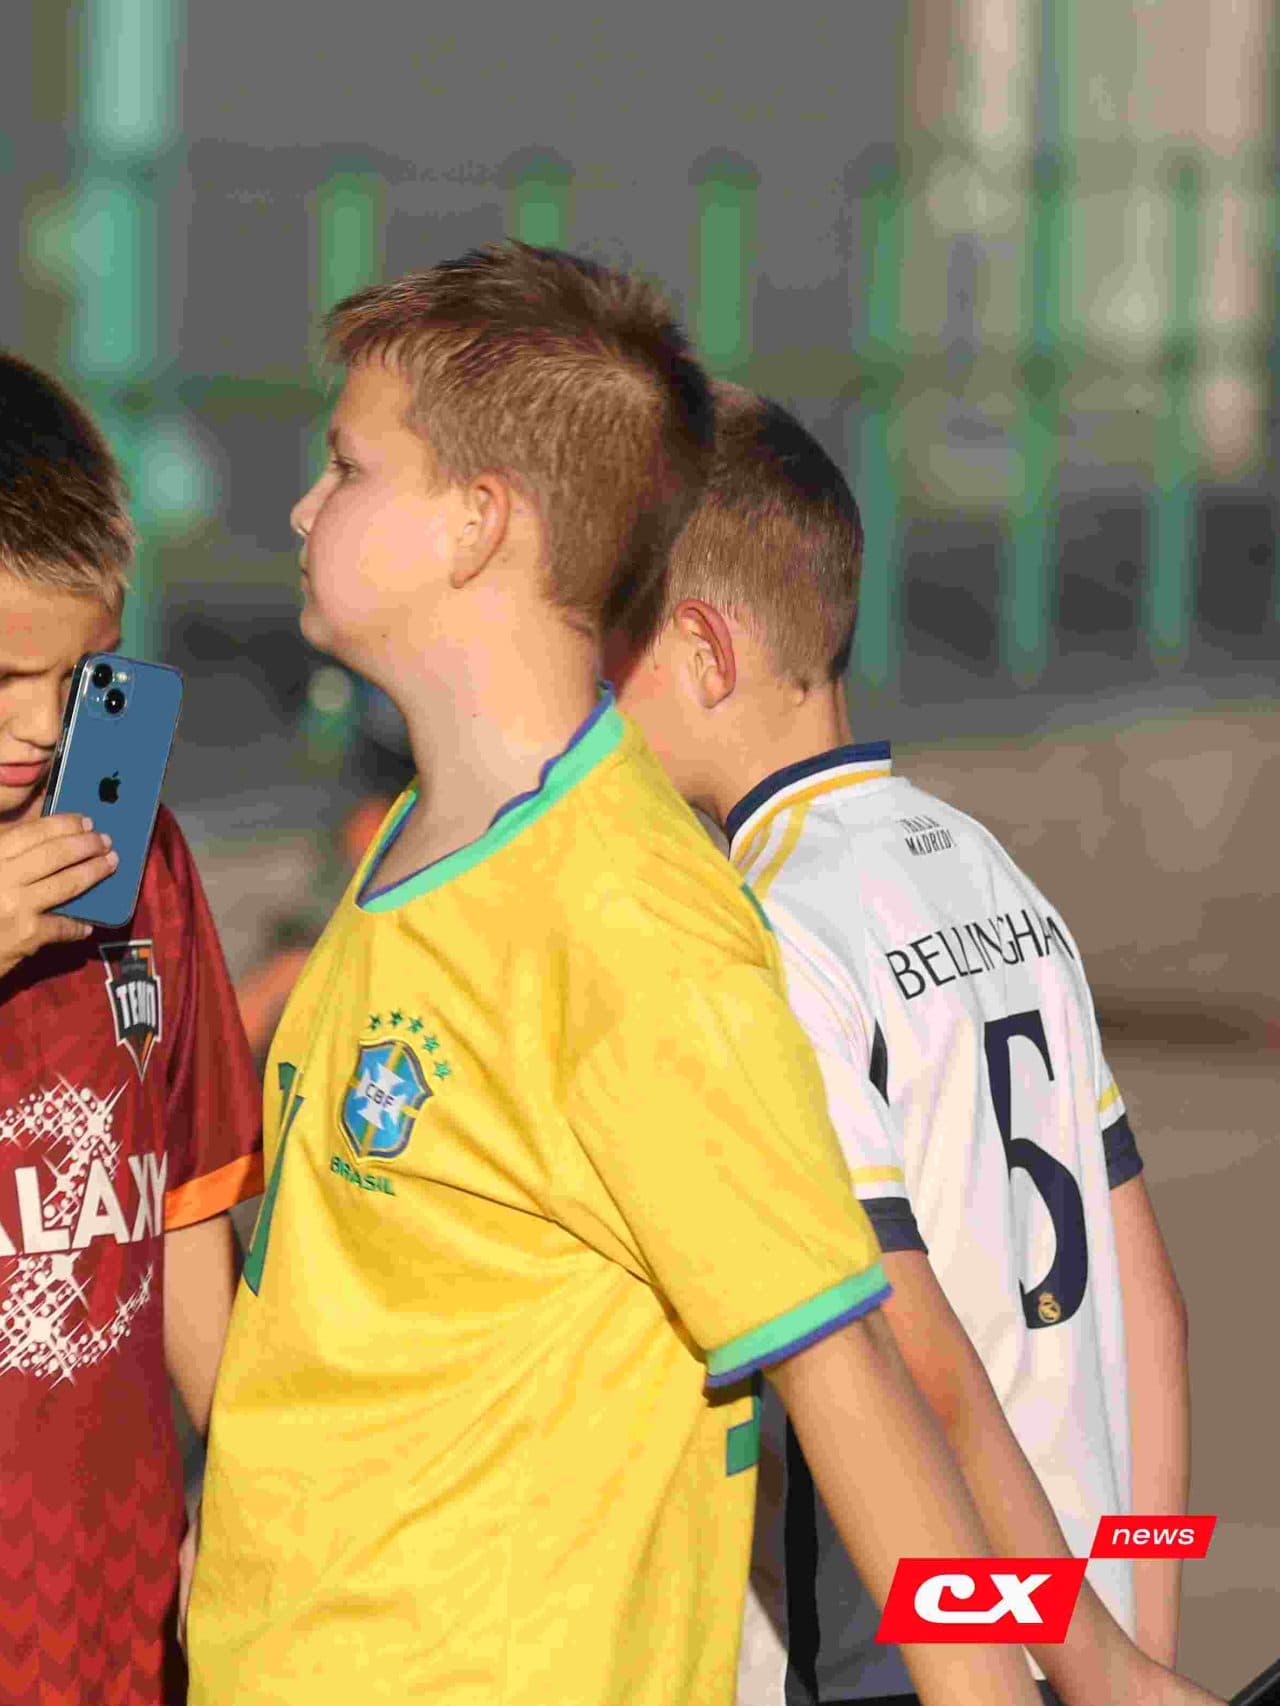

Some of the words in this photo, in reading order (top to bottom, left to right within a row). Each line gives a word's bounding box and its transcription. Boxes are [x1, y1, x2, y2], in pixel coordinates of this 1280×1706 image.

[885, 909, 1076, 1000] BELLINGHA
[365, 1083, 395, 1108] CBF
[330, 1155, 396, 1196] BRASIL
[984, 1010, 1089, 1330] 5
